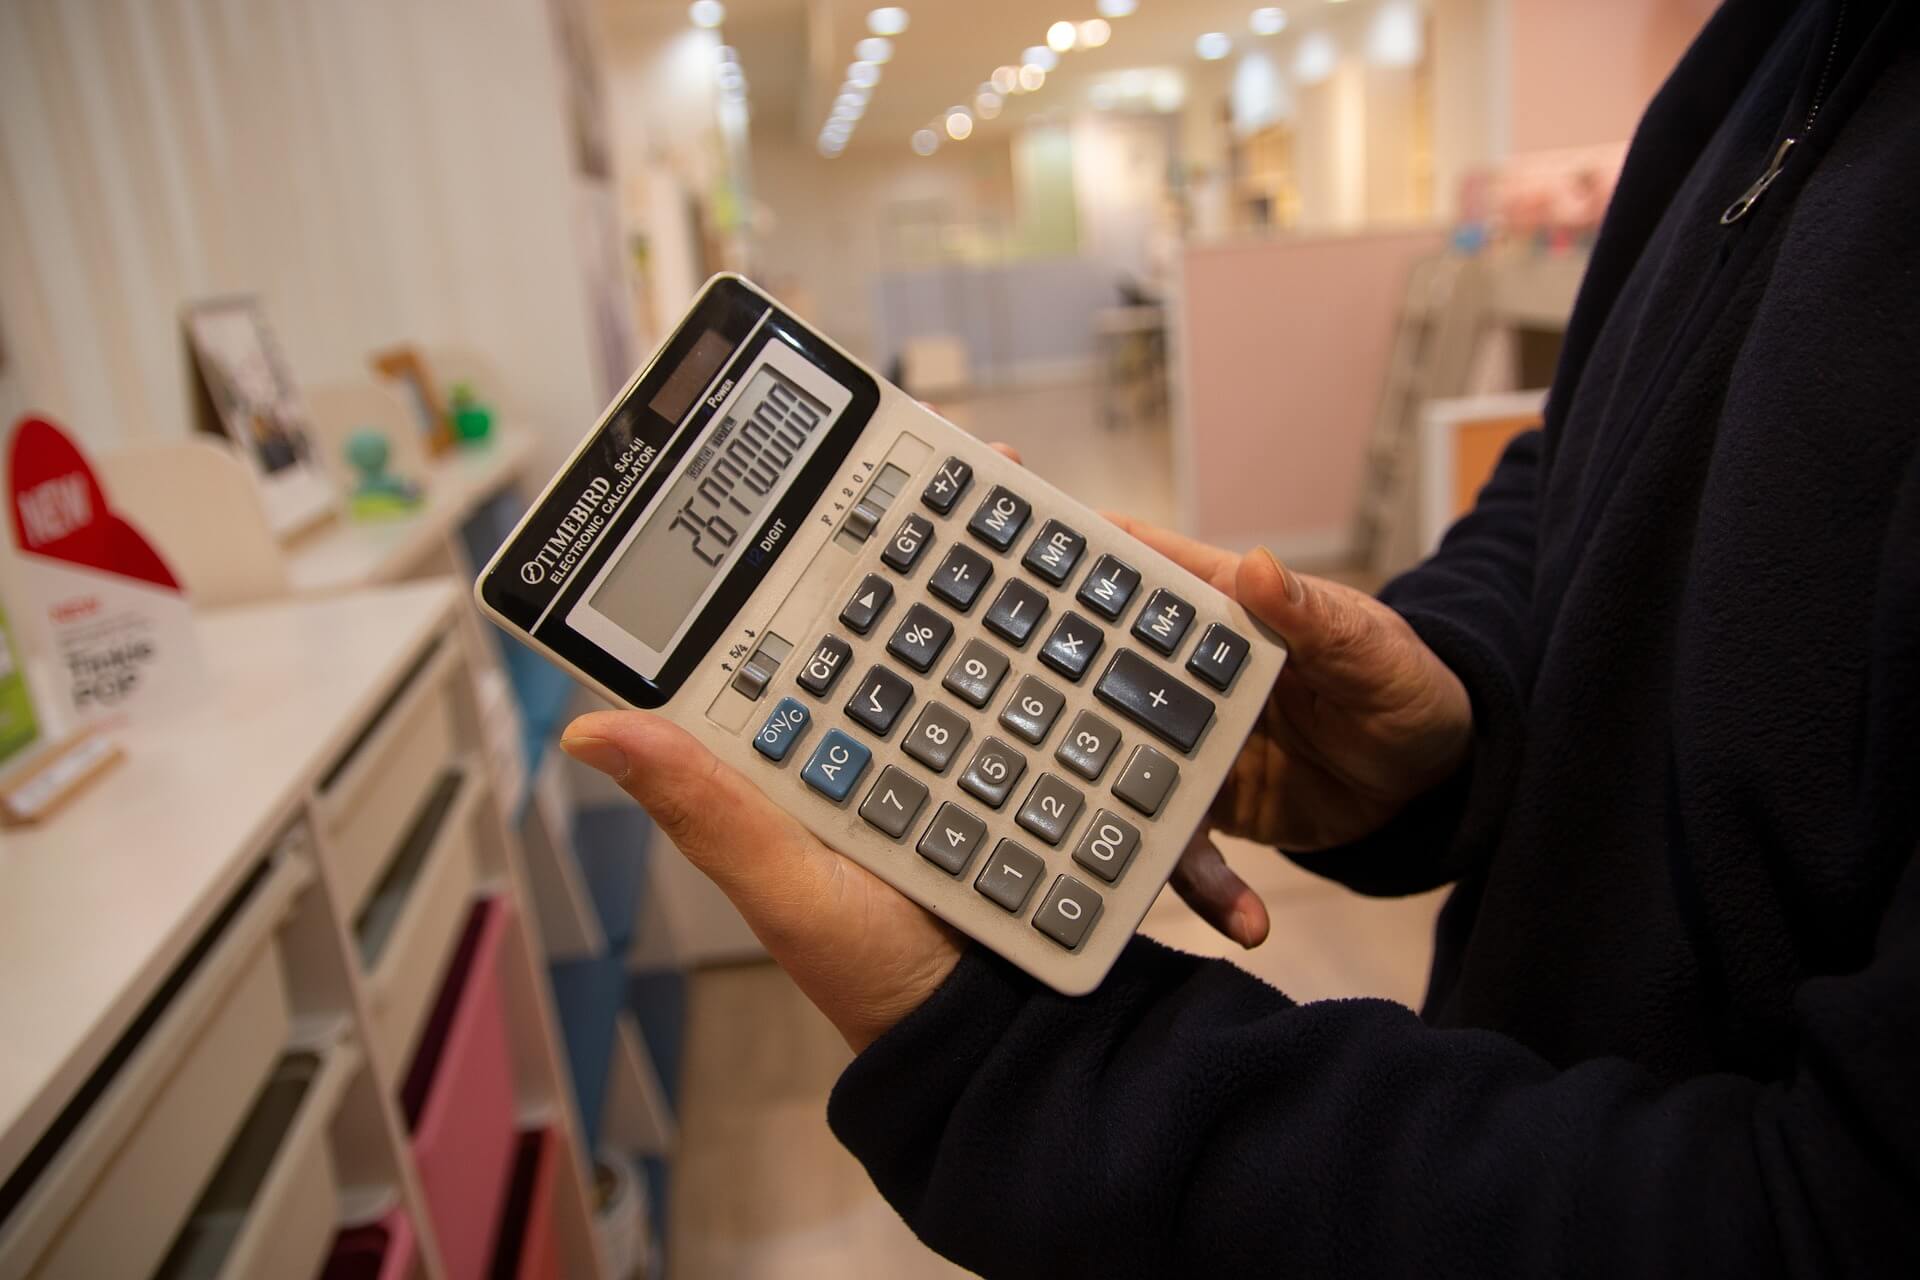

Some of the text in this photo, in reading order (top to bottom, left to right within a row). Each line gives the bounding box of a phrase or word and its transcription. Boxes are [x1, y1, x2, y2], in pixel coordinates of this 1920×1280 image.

[821, 514, 831, 527] F
[834, 501, 844, 511] 4
[843, 487, 852, 497] 2
[864, 461, 874, 471] A
[17, 470, 94, 549] NEW
[537, 476, 611, 565] TIMEBIRD
[549, 445, 657, 585] ELECTRONIC CALCULATOR
[986, 495, 1015, 532] MC
[760, 519, 787, 552] DIGIT
[897, 523, 921, 552] GT
[1042, 529, 1072, 568] MR
[1150, 601, 1179, 636] M+
[906, 624, 932, 646] %
[810, 648, 839, 678] CE
[966, 660, 987, 679] 9
[1020, 697, 1043, 720] 6
[926, 725, 948, 744] 8
[1079, 732, 1099, 752] 3
[822, 746, 848, 780] AC
[986, 758, 1005, 779] 5
[882, 790, 903, 810] 7
[1042, 797, 1065, 818] 2
[946, 828, 965, 846] 4
[1088, 821, 1122, 860] 00
[1004, 865, 1022, 878] 1
[1058, 899, 1081, 919] 0
